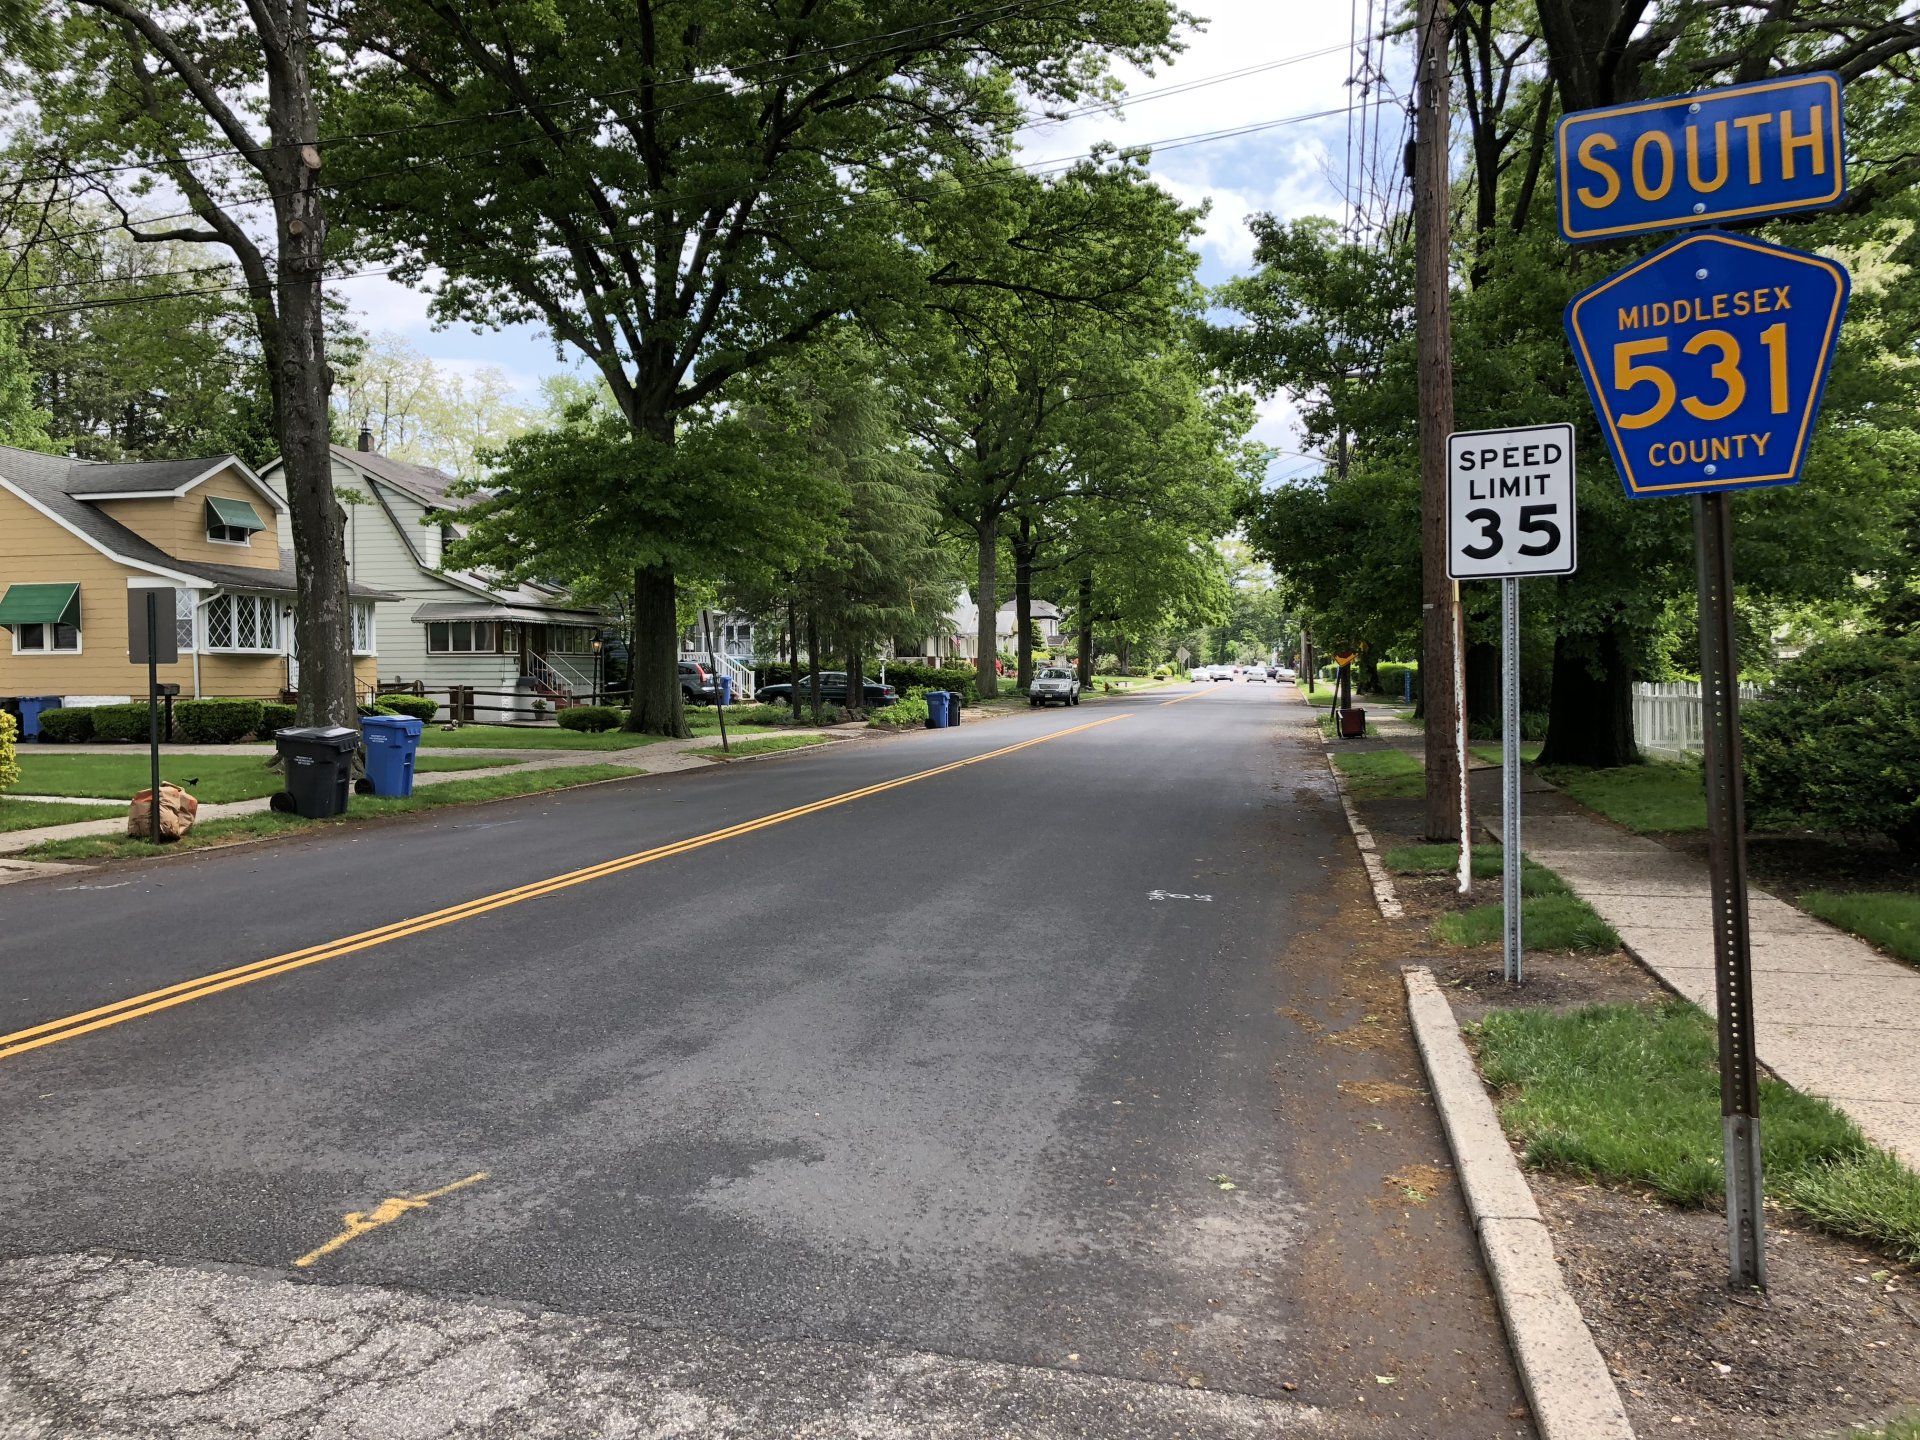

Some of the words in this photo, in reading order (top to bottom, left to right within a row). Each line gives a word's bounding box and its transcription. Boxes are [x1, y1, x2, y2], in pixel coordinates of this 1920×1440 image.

[1576, 105, 1826, 209] SOUTH
[1617, 286, 1792, 331] MIDDLESEX
[1612, 322, 1789, 430] 531
[1458, 442, 1563, 472] SPEED
[1648, 432, 1771, 467] COUNTY
[1469, 473, 1551, 501] LIMIT
[1460, 503, 1562, 560] 35
